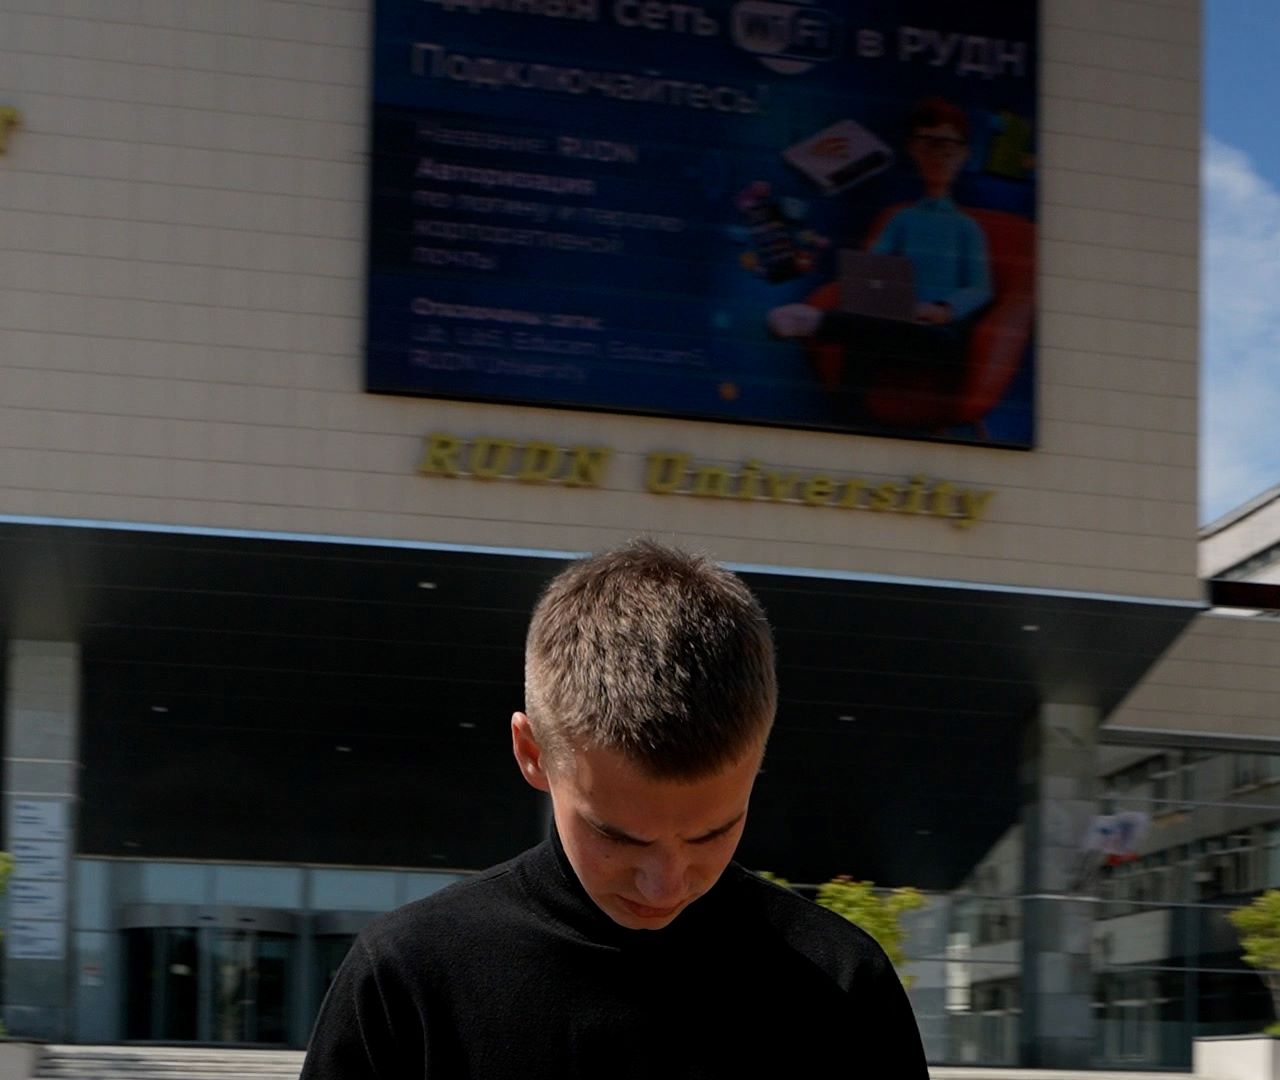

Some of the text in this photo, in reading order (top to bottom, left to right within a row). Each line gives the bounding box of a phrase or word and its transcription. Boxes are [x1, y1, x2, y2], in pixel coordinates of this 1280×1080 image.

[896, 24, 1030, 79] РУДН
[420, 432, 997, 530] RUDN University
